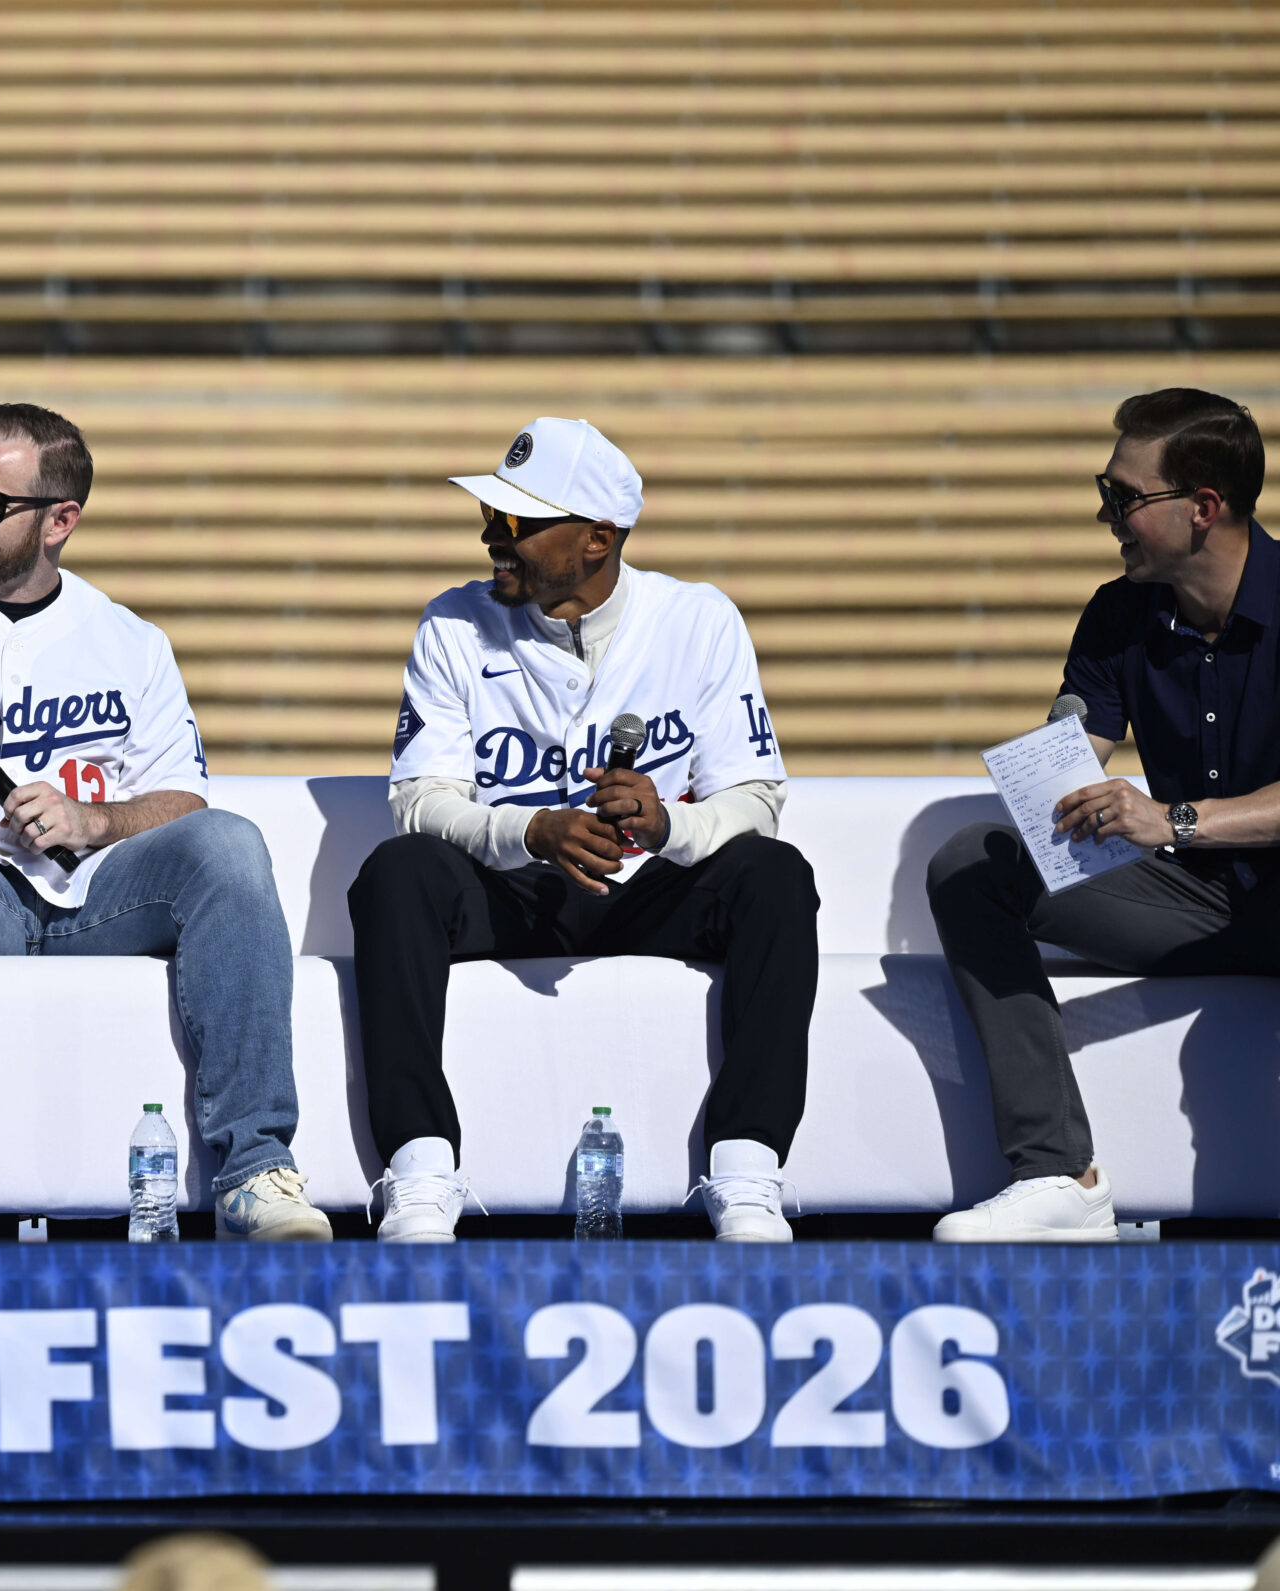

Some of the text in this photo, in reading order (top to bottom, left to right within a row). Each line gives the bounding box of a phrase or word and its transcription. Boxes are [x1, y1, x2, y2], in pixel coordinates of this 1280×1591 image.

[475, 709, 695, 792] Dodrs
[740, 693, 776, 757] LA
[1253, 1307, 1280, 1331] D
[524, 1302, 1010, 1449] 2026
